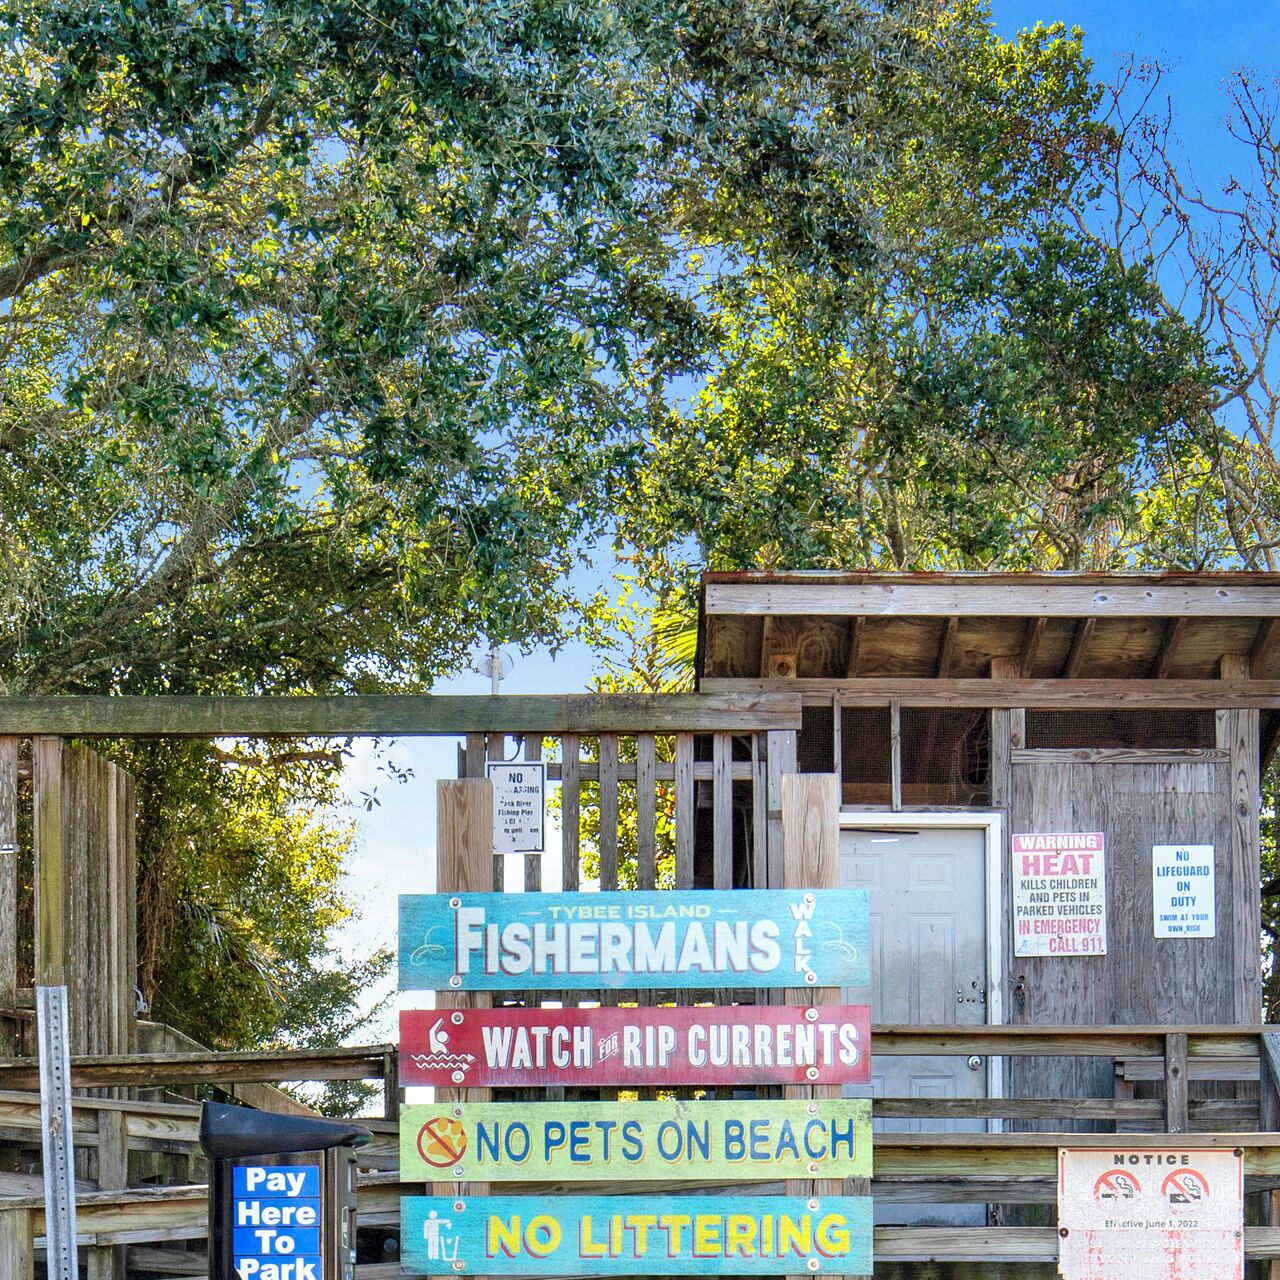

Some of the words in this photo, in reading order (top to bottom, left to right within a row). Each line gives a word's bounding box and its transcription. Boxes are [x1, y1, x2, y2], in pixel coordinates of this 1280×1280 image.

[509, 773, 523, 783] NO
[1019, 836, 1097, 849] WARNING
[1176, 851, 1189, 861] NO
[1022, 854, 1094, 876] HEAT
[1157, 866, 1210, 876] LIFEGUARD
[1020, 879, 1047, 889] KILLS
[1050, 879, 1097, 889] CHILDREN
[1177, 882, 1190, 892] ON
[1029, 893, 1050, 902] AND
[1053, 892, 1076, 902] PETS
[1080, 892, 1090, 901] IN
[1171, 896, 1197, 907] DUTY
[548, 905, 620, 920] TYBEE
[627, 905, 711, 919] ISLAND
[1017, 906, 1054, 916] PARKED
[1057, 905, 1102, 915] VEHICLES
[1019, 920, 1030, 934] IN
[1034, 919, 1100, 934] EMERGENCY
[789, 902, 815, 972] WALK
[1049, 938, 1078, 952] CALL
[1082, 938, 1102, 952] 911
[482, 1025, 593, 1069] WATCH
[599, 1035, 618, 1058] FOR
[623, 1026, 676, 1067] RIP
[688, 1023, 859, 1066] CURRENTS
[476, 1121, 532, 1162] NO
[544, 1119, 644, 1162] PETS
[657, 1119, 711, 1161] ON
[724, 1119, 854, 1160] BEACH
[1114, 1155, 1189, 1165] NOTICE
[246, 1168, 305, 1197] Pay
[238, 1202, 316, 1225] Here
[1145, 1220, 1165, 1229] June
[255, 1230, 295, 1254] To
[486, 1215, 561, 1258] NO
[579, 1214, 851, 1258] LITTERING
